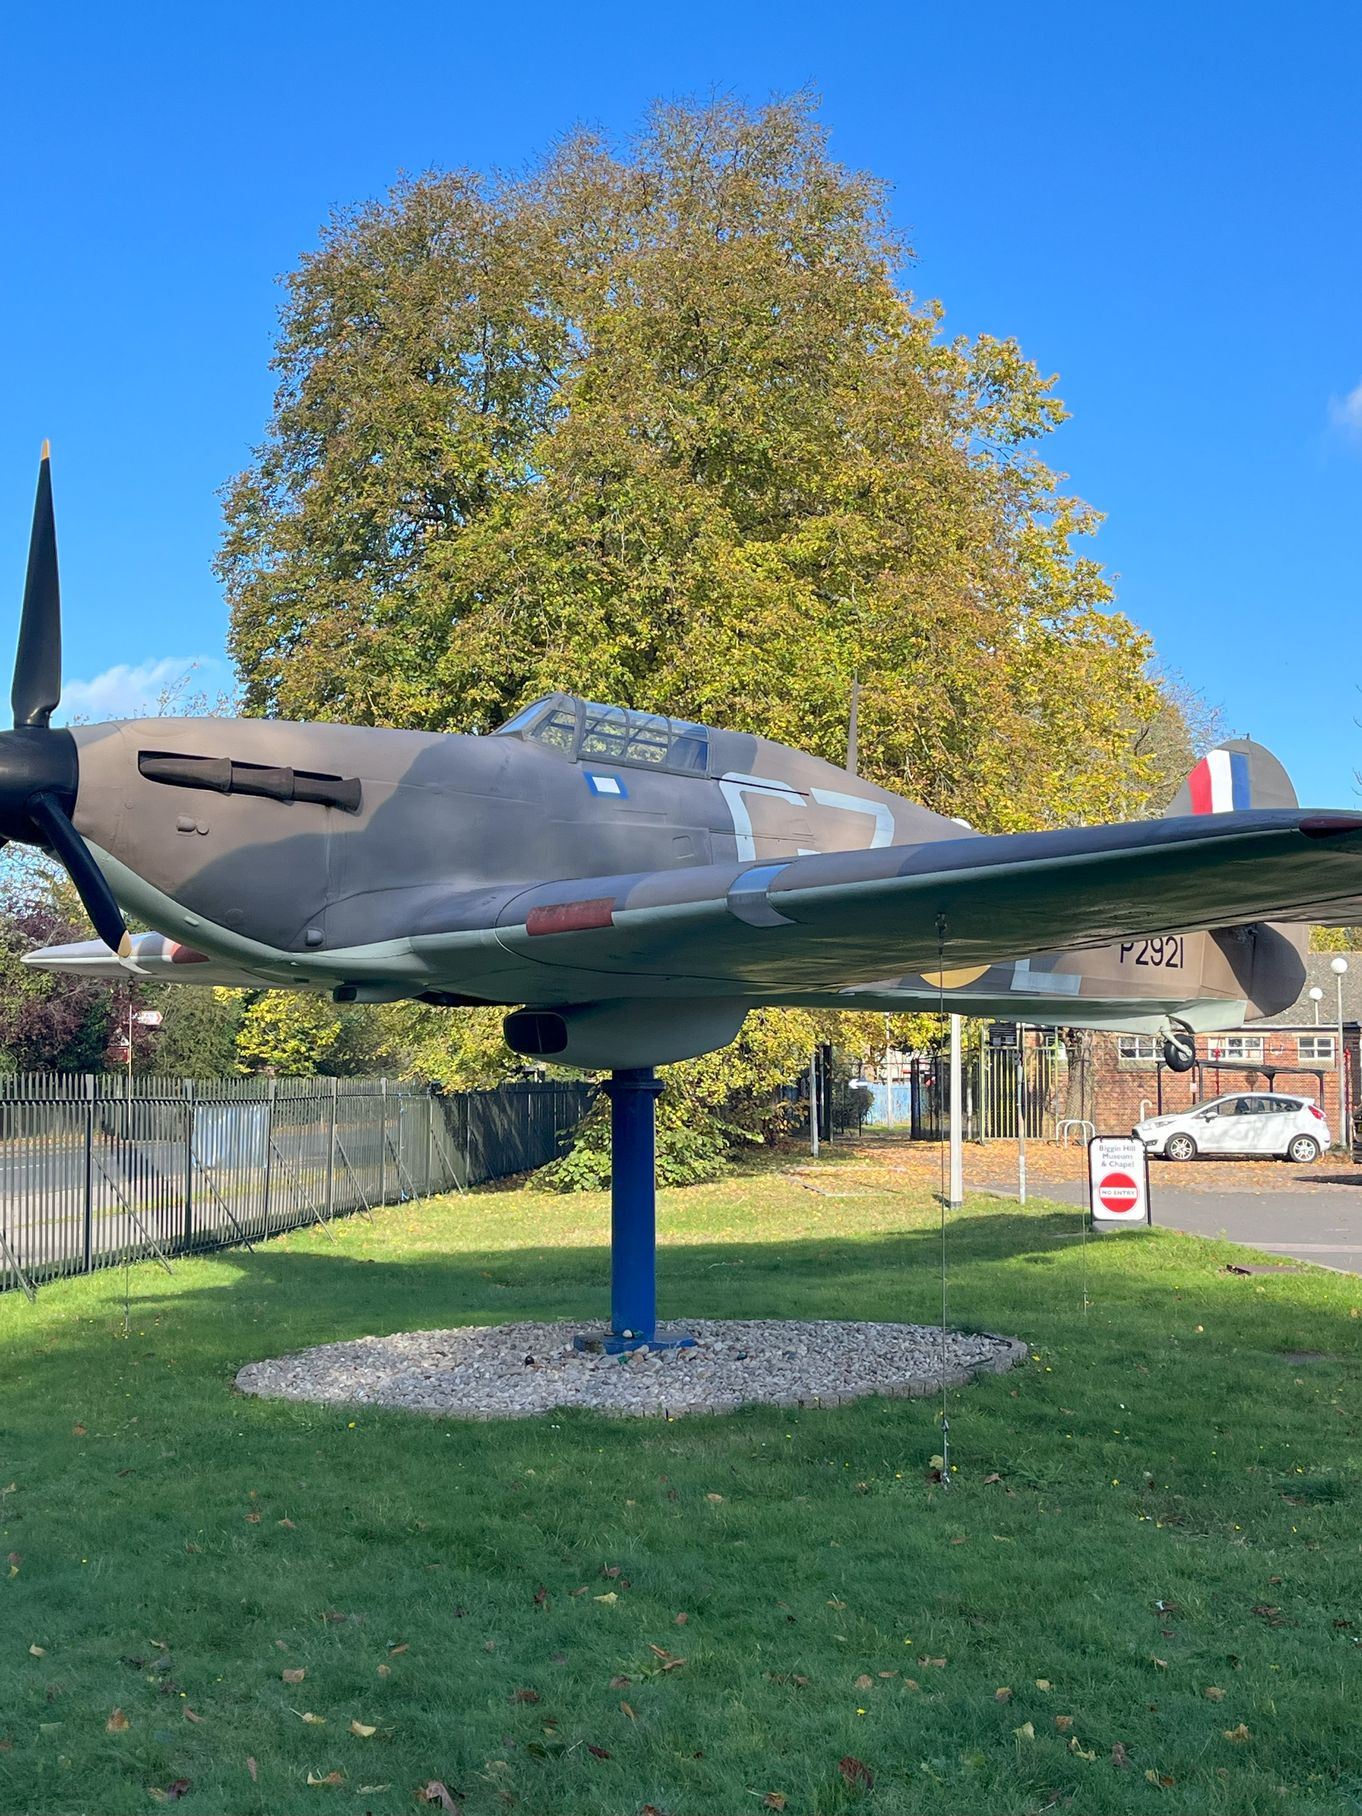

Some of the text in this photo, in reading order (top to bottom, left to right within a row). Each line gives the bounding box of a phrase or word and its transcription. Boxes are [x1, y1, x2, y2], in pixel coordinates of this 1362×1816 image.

[1120, 935, 1184, 969] P2921
[1099, 1145, 1121, 1153] Biggin
[1108, 1161, 1135, 1169] Chapel
